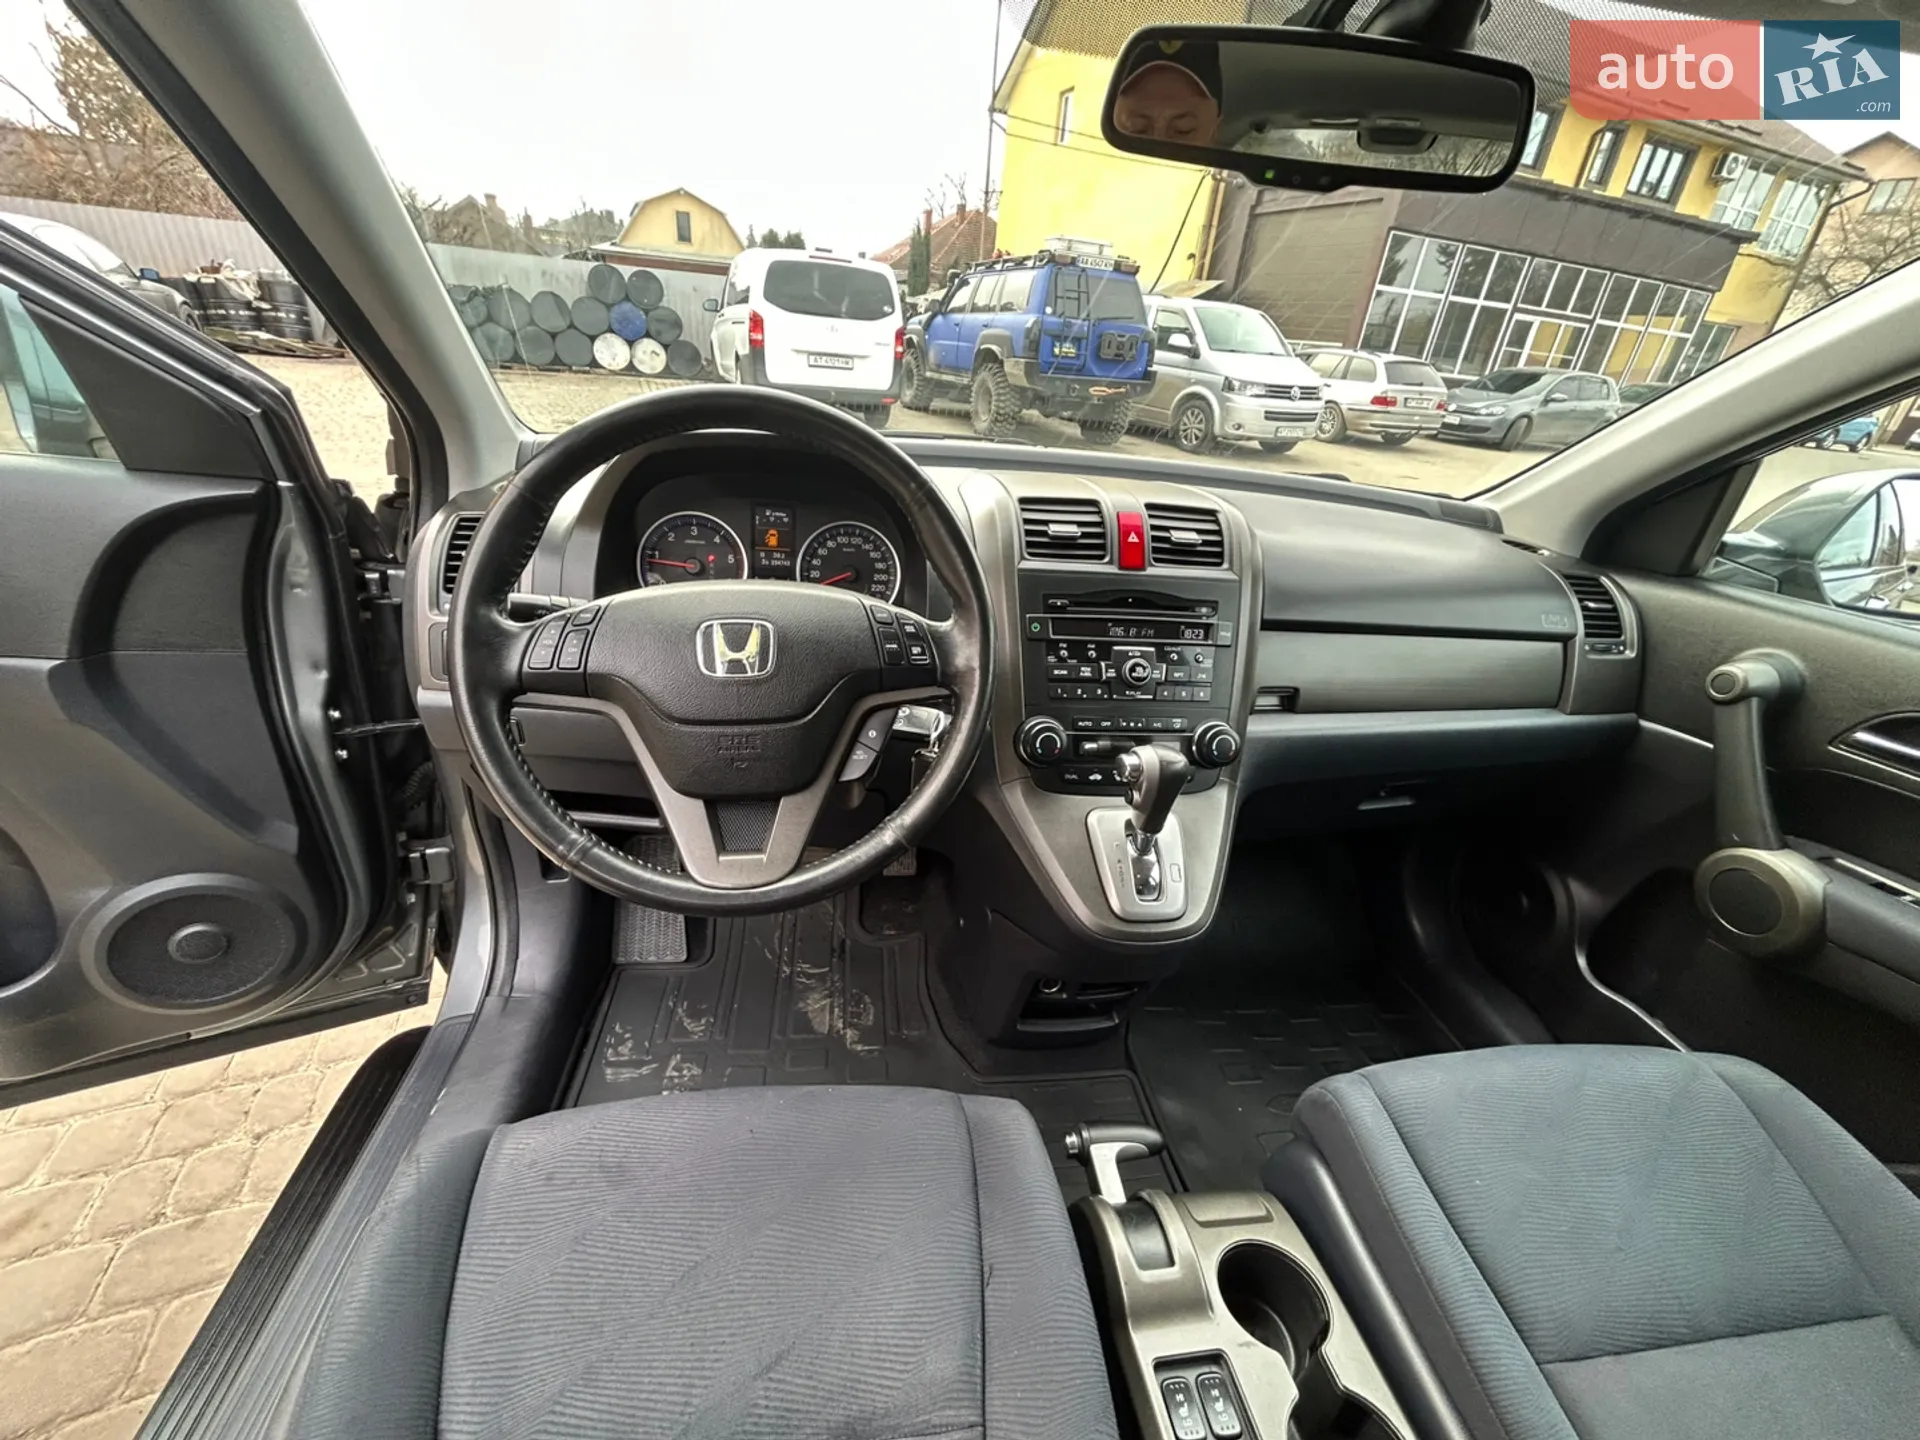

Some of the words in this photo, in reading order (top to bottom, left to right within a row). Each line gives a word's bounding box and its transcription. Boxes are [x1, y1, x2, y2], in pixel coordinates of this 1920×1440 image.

[690, 526, 698, 536] 3
[667, 532, 675, 541] 2
[713, 534, 720, 544] 4
[836, 535, 849, 544] 100
[850, 536, 863, 545] 120
[826, 540, 837, 549] 80
[861, 542, 874, 551] 140
[817, 547, 828, 556] 60
[869, 551, 882, 559] 160
[727, 554, 735, 564] 5
[811, 558, 822, 567] 40
[874, 562, 887, 570] 180
[809, 570, 820, 579] 20
[873, 573, 888, 581] 200
[870, 583, 887, 592] 220
